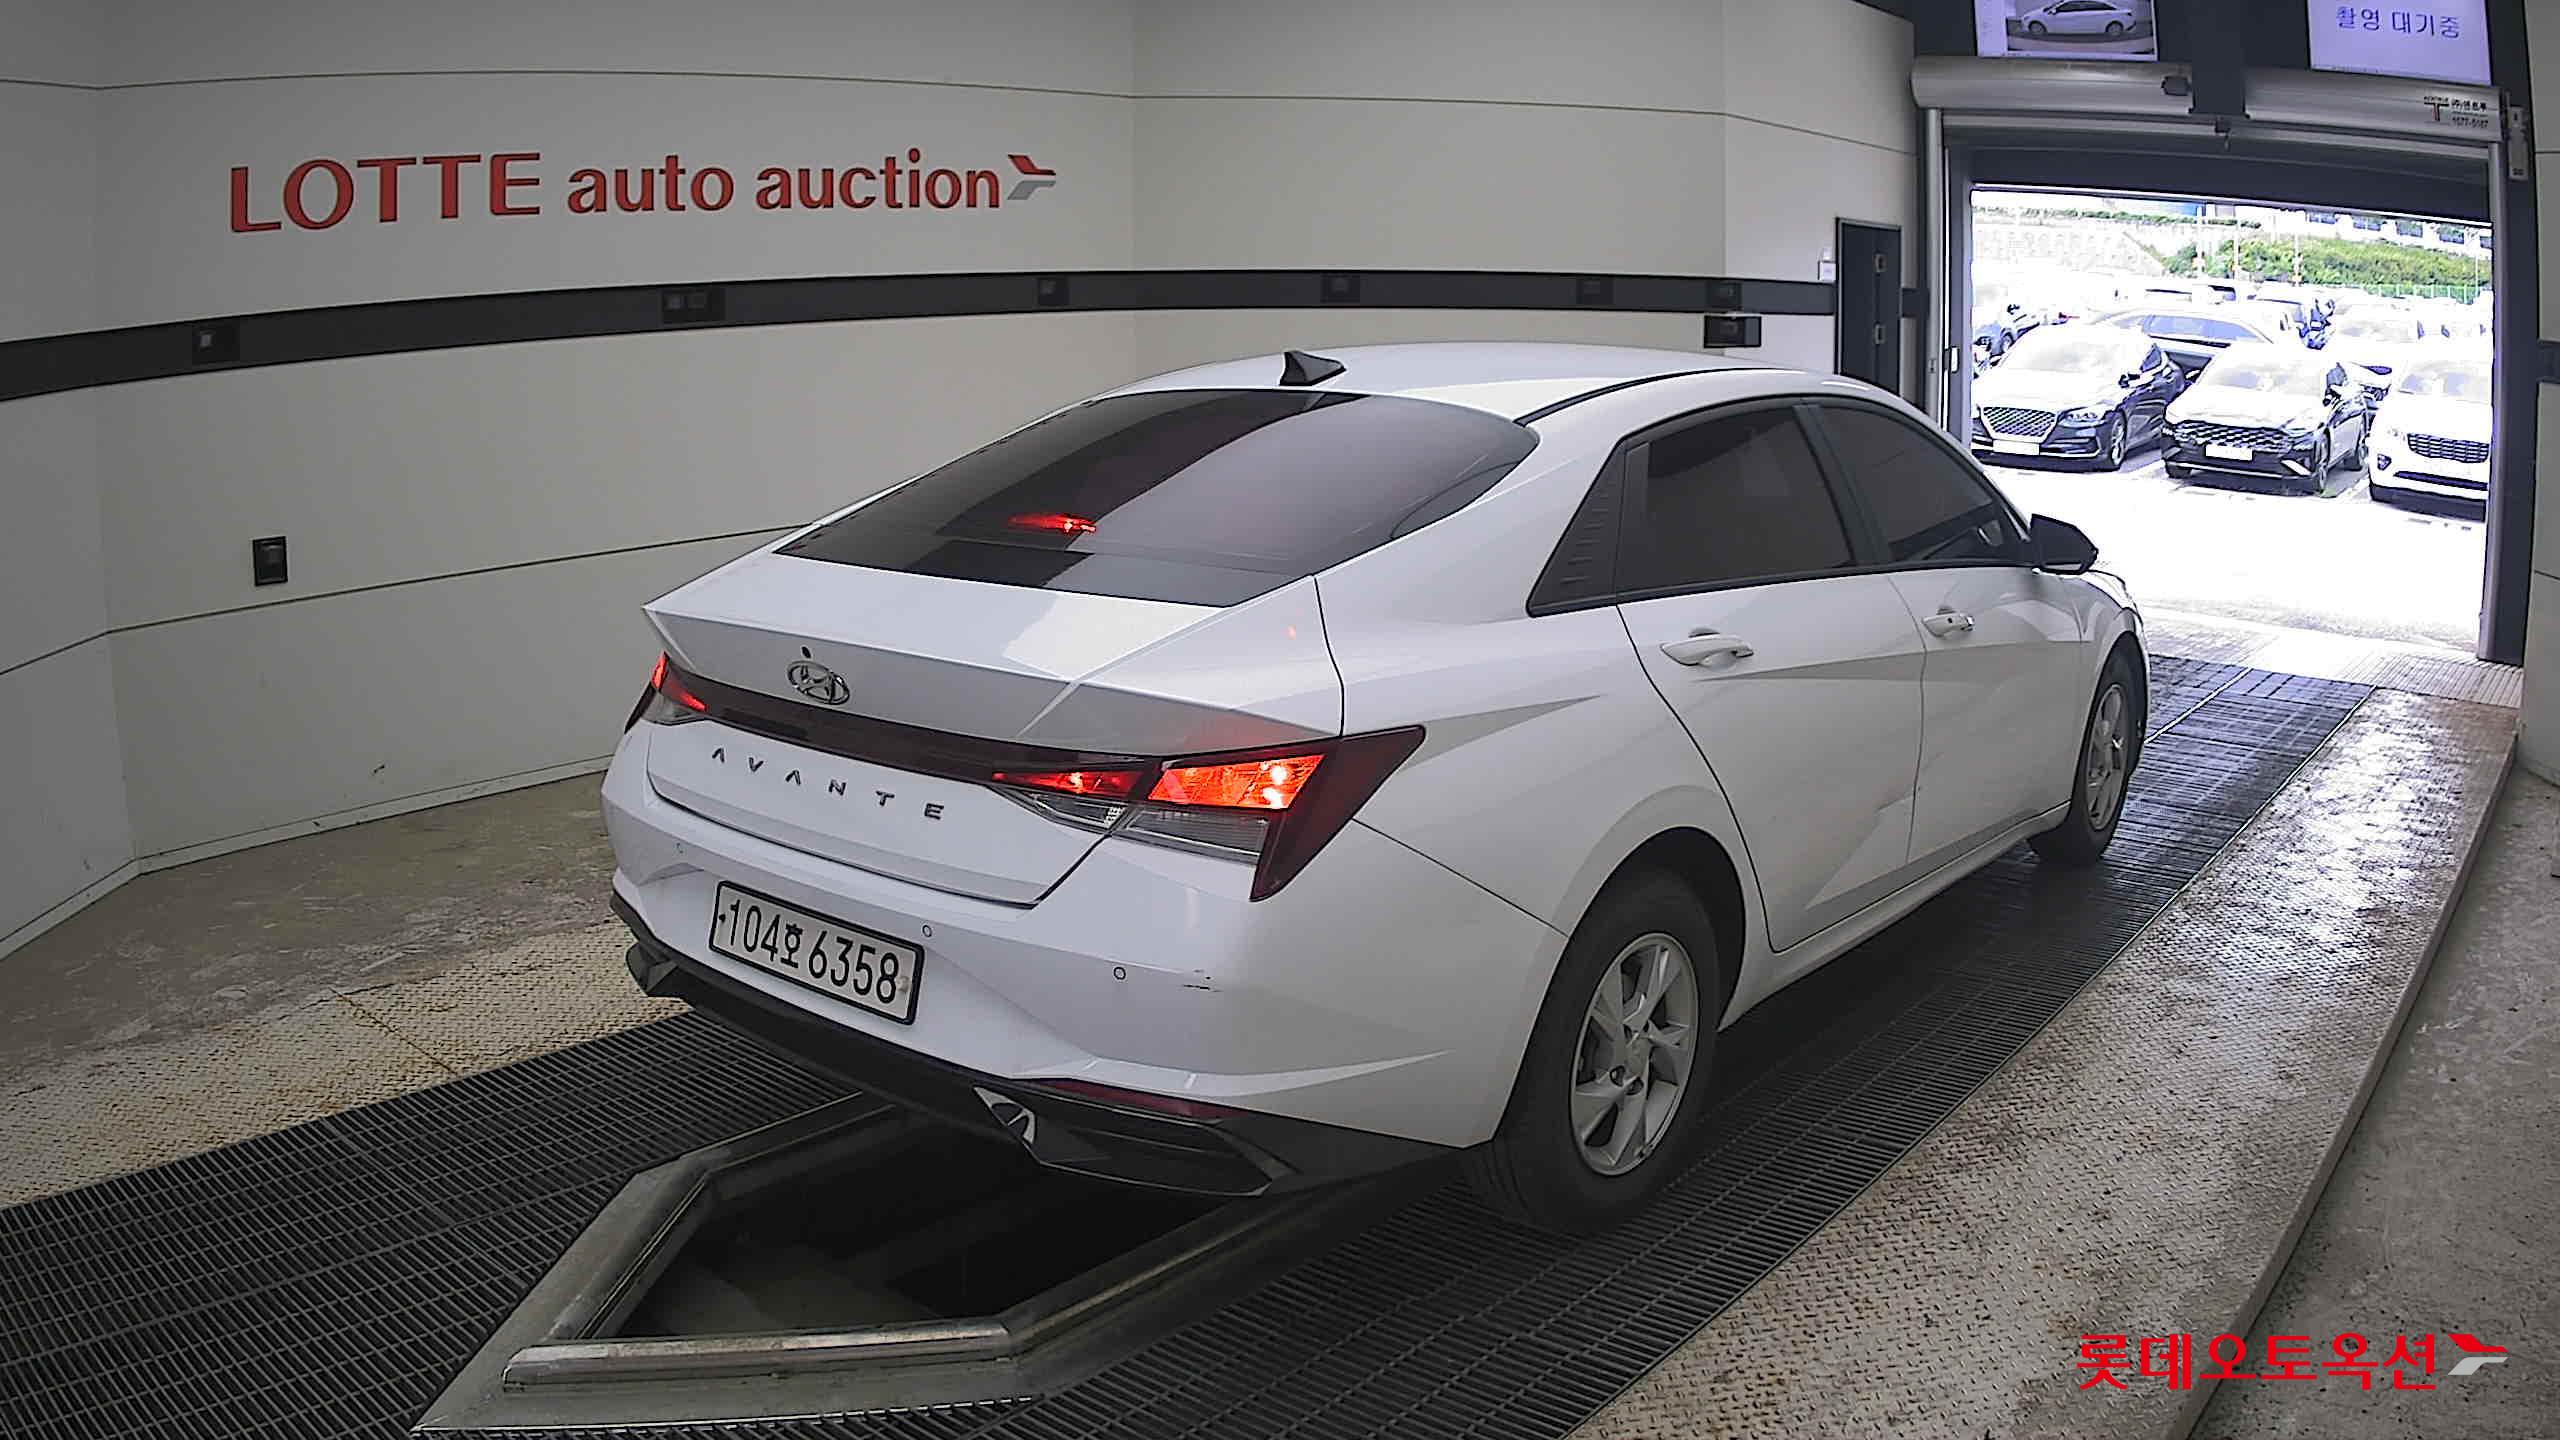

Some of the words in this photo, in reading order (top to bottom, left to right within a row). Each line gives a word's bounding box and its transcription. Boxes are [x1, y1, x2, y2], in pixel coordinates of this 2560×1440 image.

[2336, 6, 2380, 31] 촬영
[2391, 11, 2460, 39] 대기중
[230, 152, 541, 233] LOTTE
[567, 154, 735, 214] auto
[756, 147, 1001, 211] auction
[711, 747, 945, 820] AVANTE
[808, 930, 899, 1004] 6358
